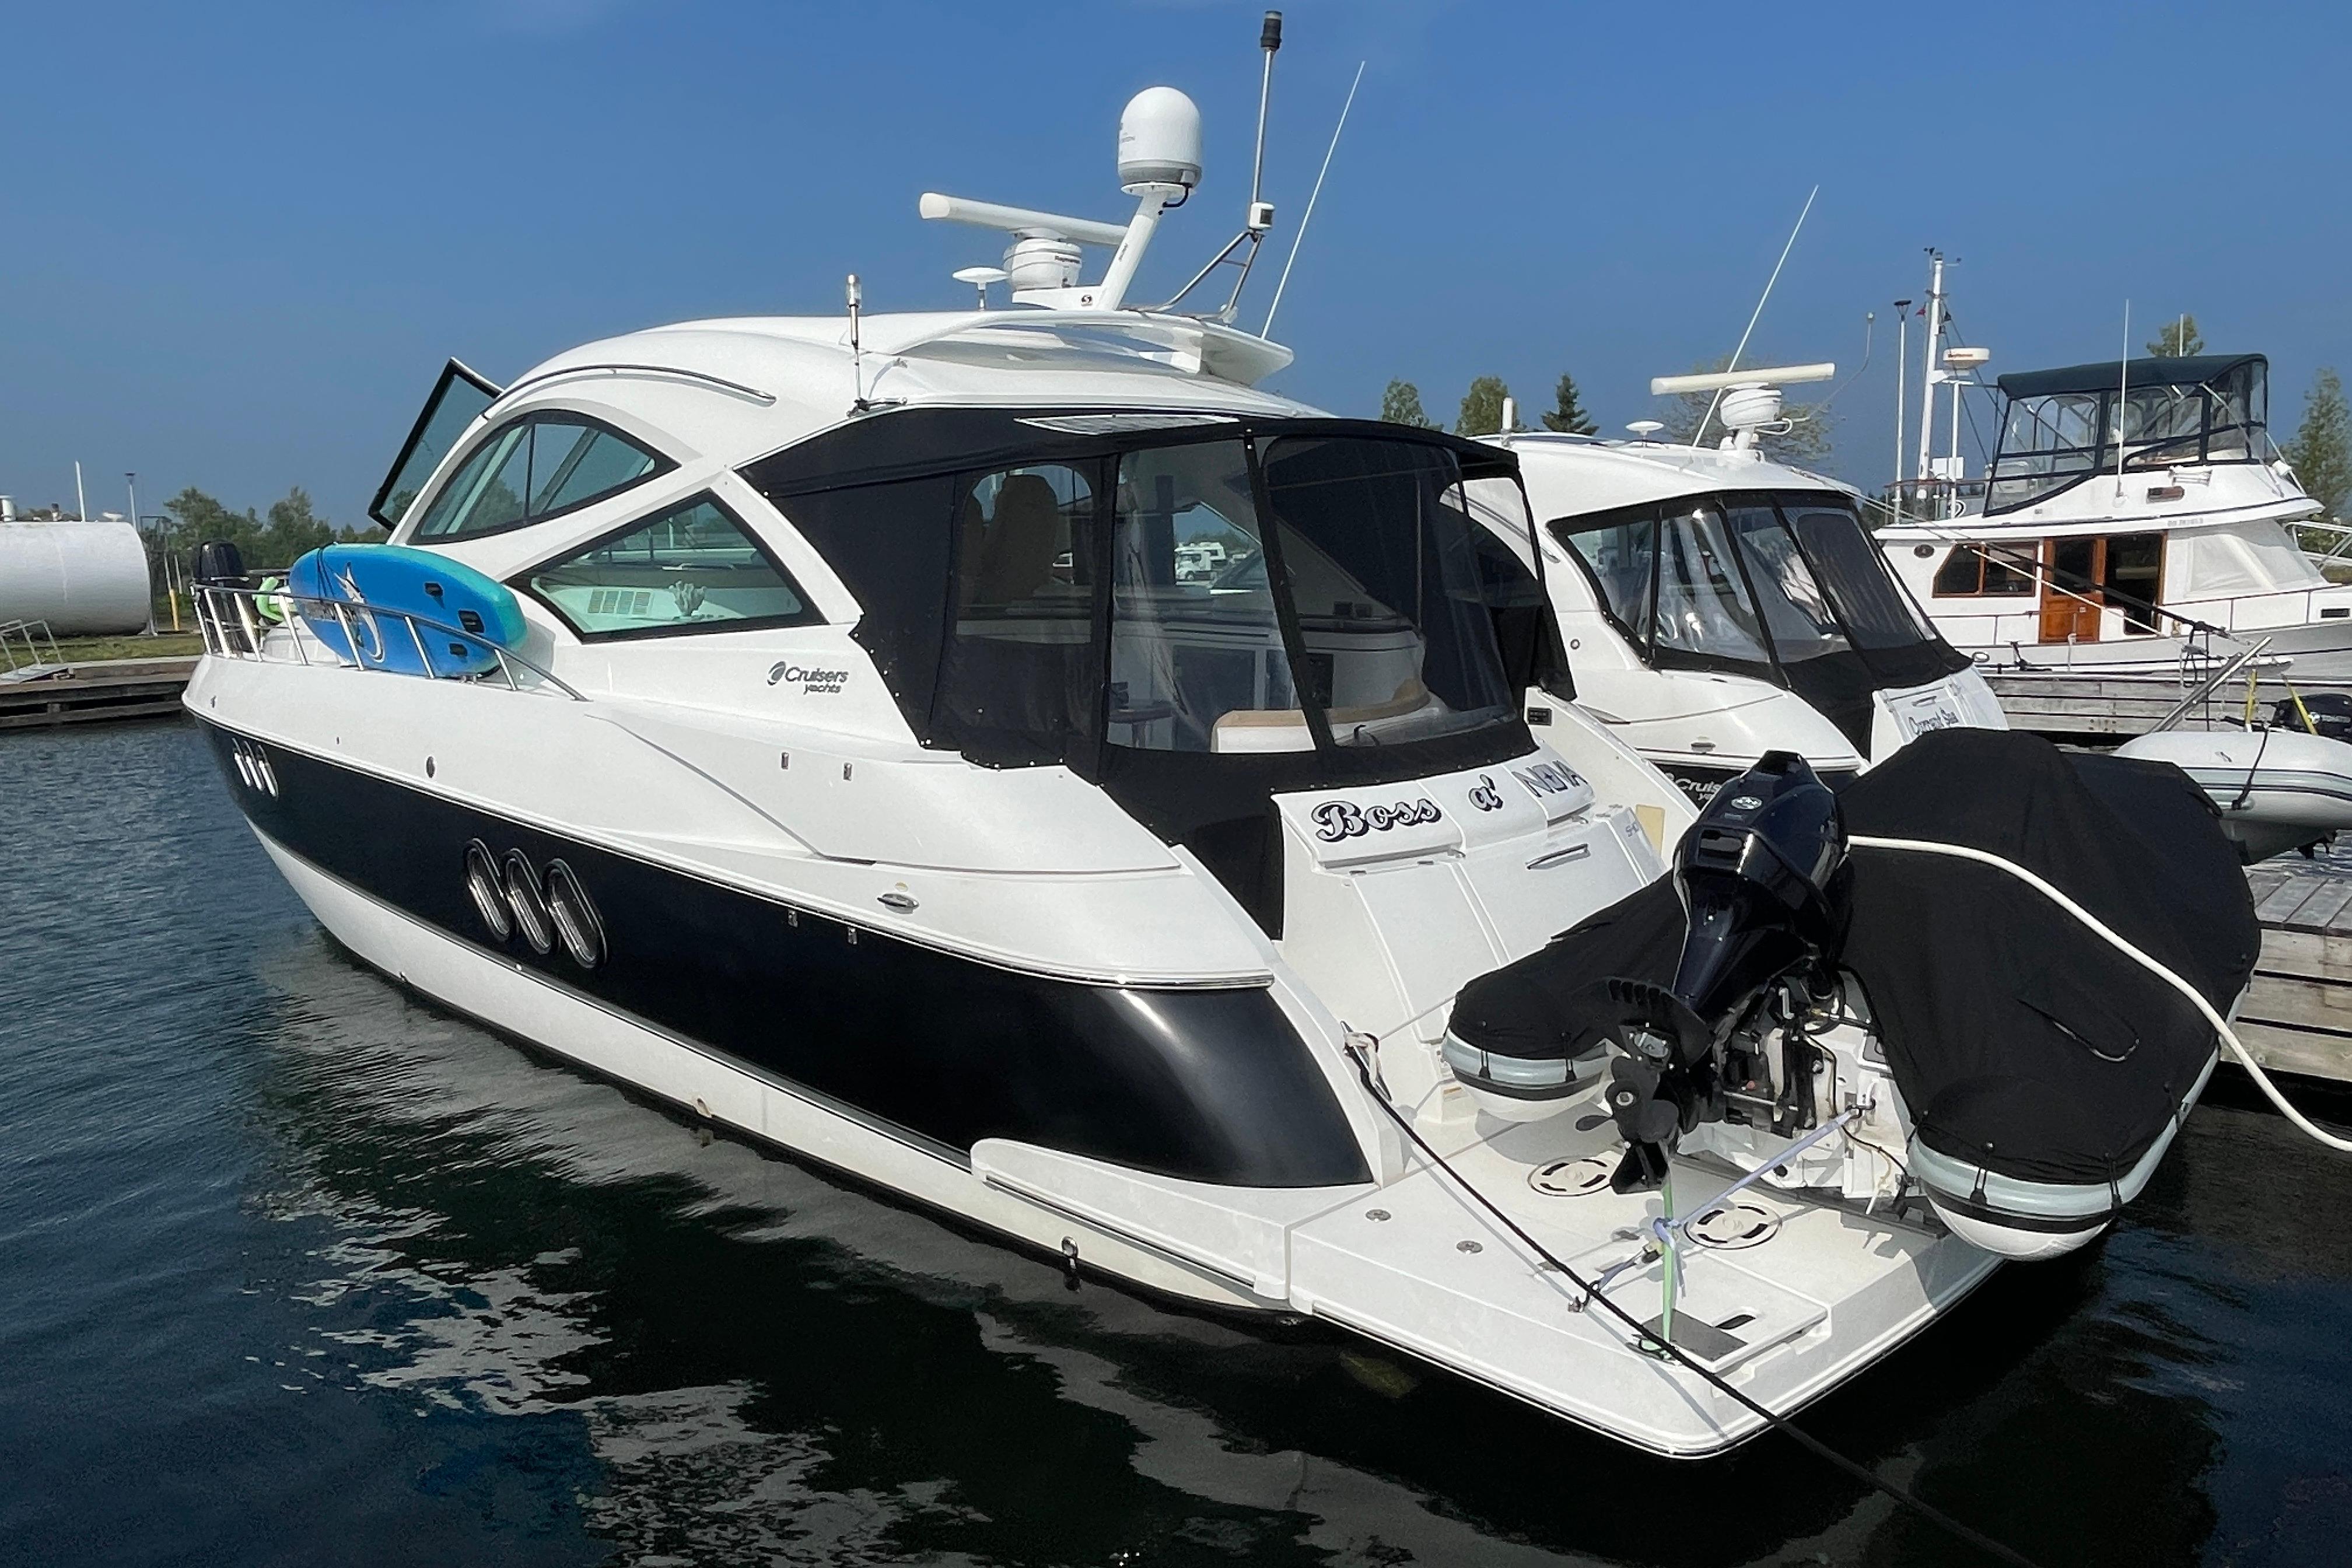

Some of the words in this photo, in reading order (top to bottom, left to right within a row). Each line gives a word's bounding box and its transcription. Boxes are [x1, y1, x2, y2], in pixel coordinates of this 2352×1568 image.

[785, 667, 849, 682] Cruisers
[803, 683, 841, 695] yachts
[1311, 798, 1443, 842] Boss
